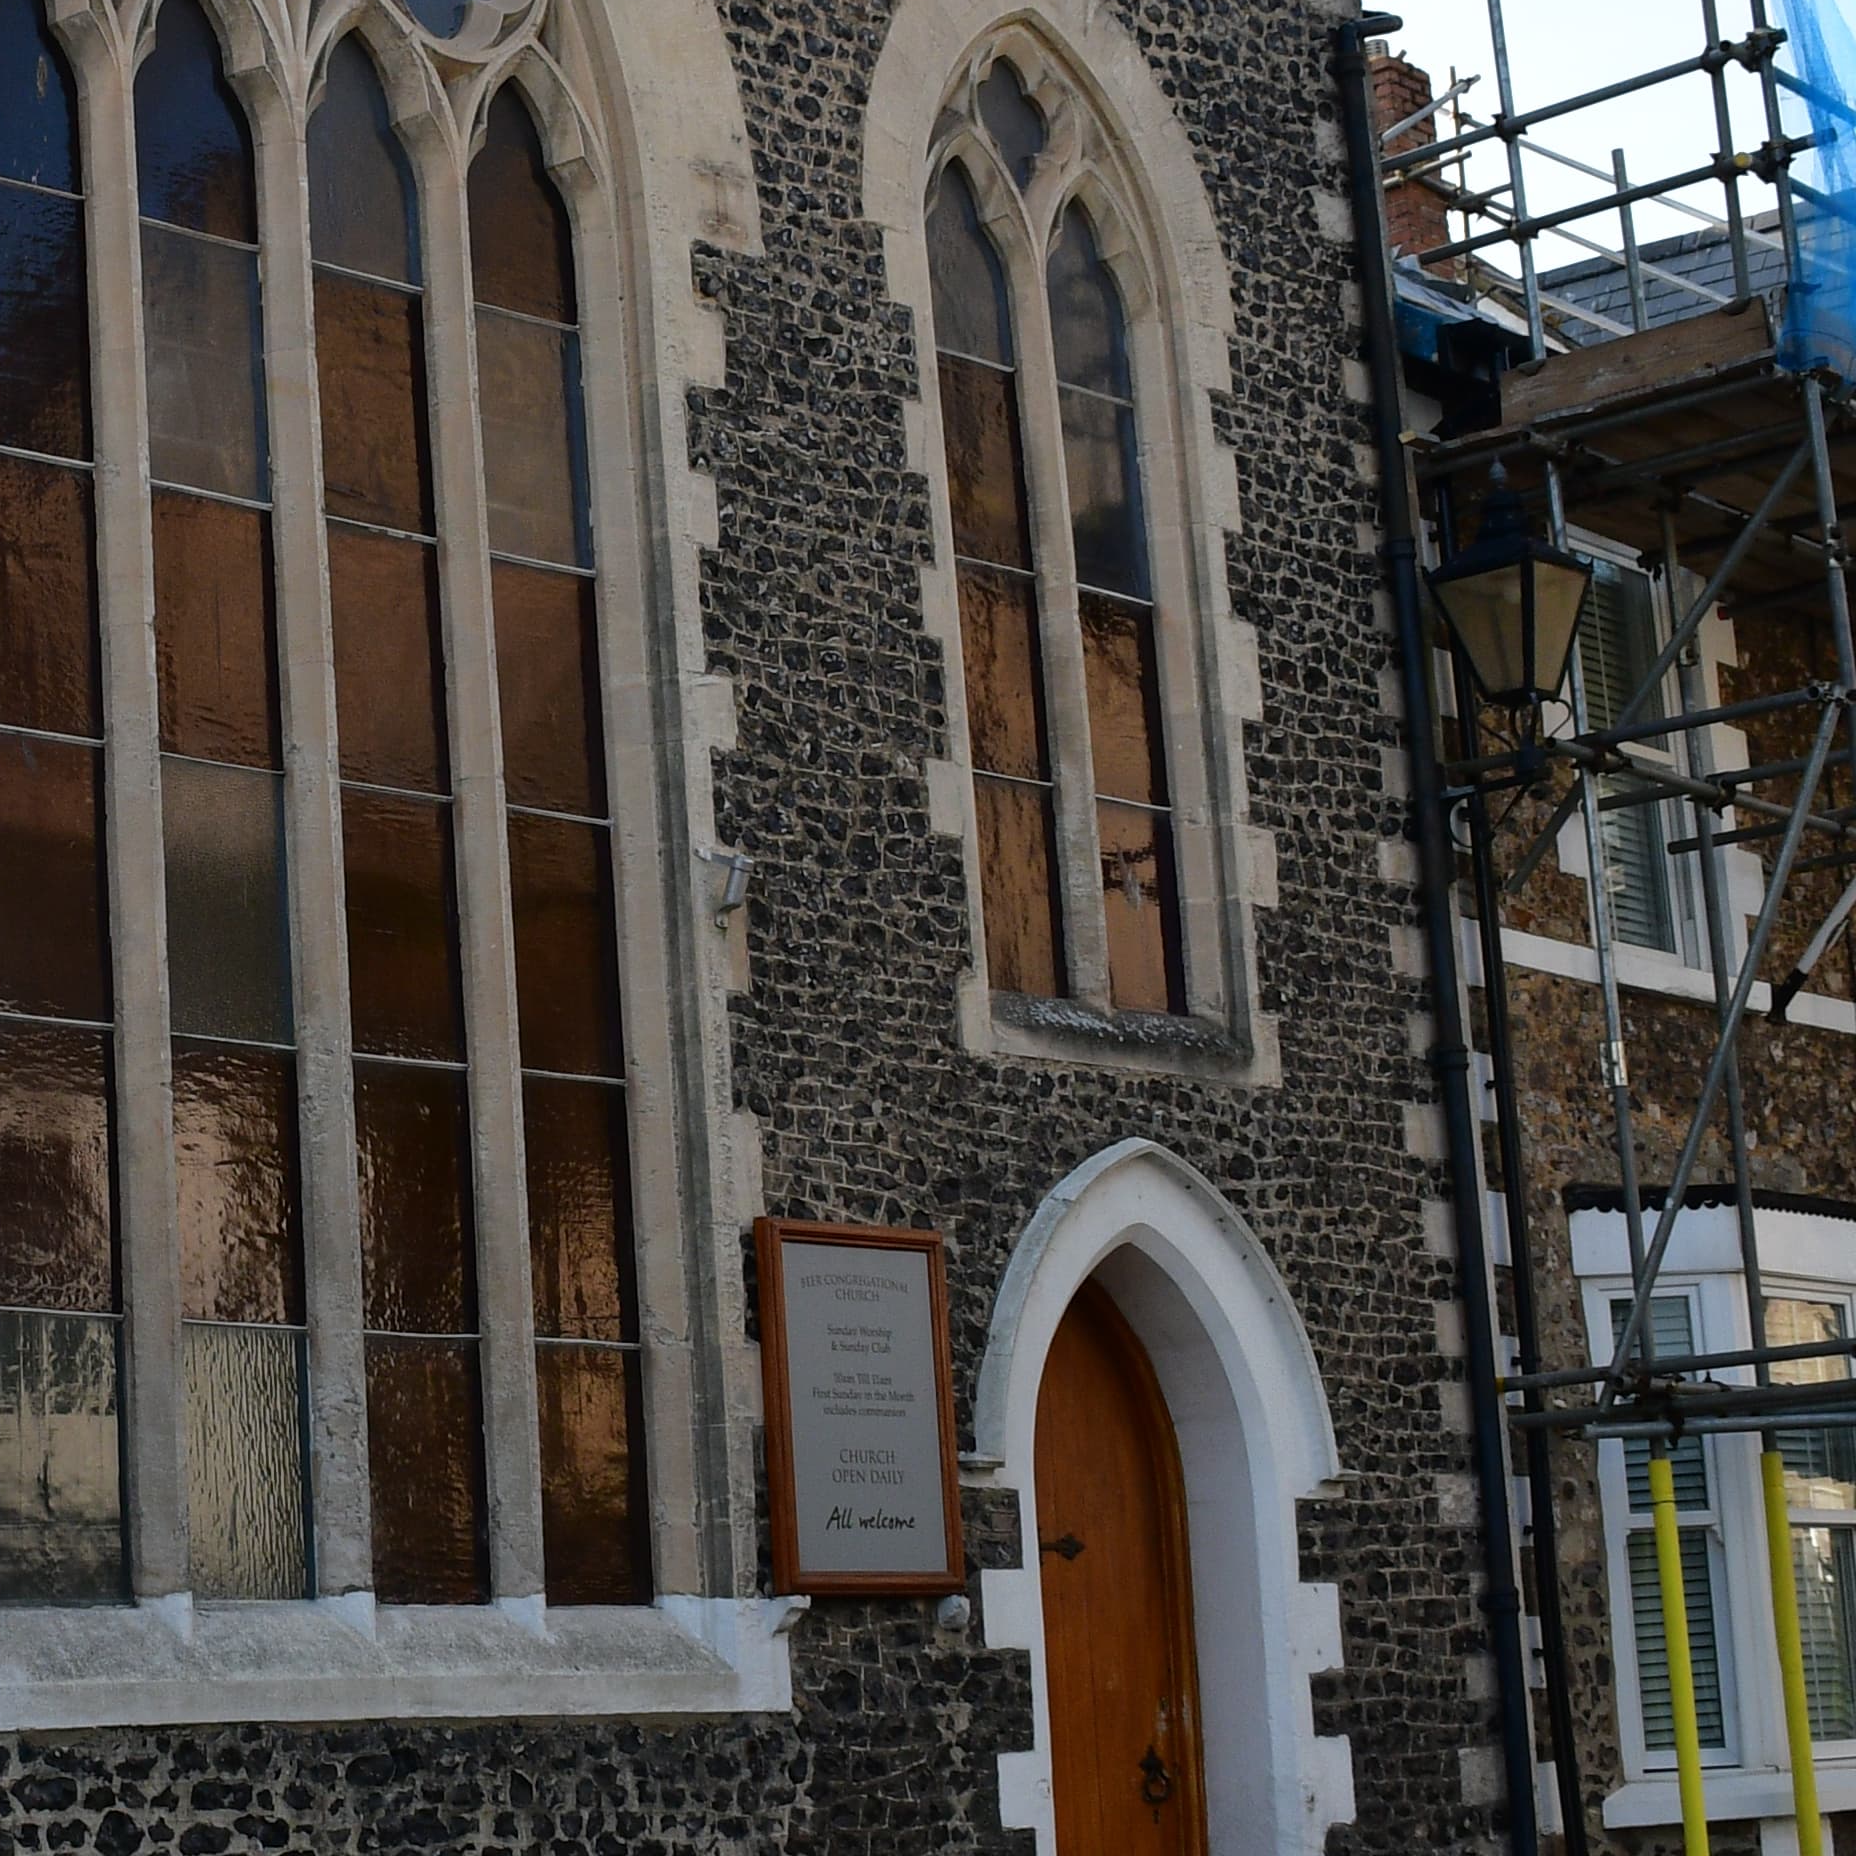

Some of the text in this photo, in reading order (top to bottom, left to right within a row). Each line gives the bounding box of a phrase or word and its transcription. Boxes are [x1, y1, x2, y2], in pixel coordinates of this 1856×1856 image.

[834, 1288, 880, 1302] CHURCH
[827, 1324, 893, 1340] Sunday Worship
[839, 1342, 869, 1356] Sunday
[871, 1343, 891, 1353] Club
[812, 1387, 831, 1399] First
[832, 1389, 861, 1402] Sunday
[874, 1390, 886, 1401] the
[888, 1391, 916, 1402] Month
[840, 1449, 896, 1465] CHURCH
[832, 1469, 905, 1485] OPEN DAILY
[825, 1505, 916, 1531] All welcome
